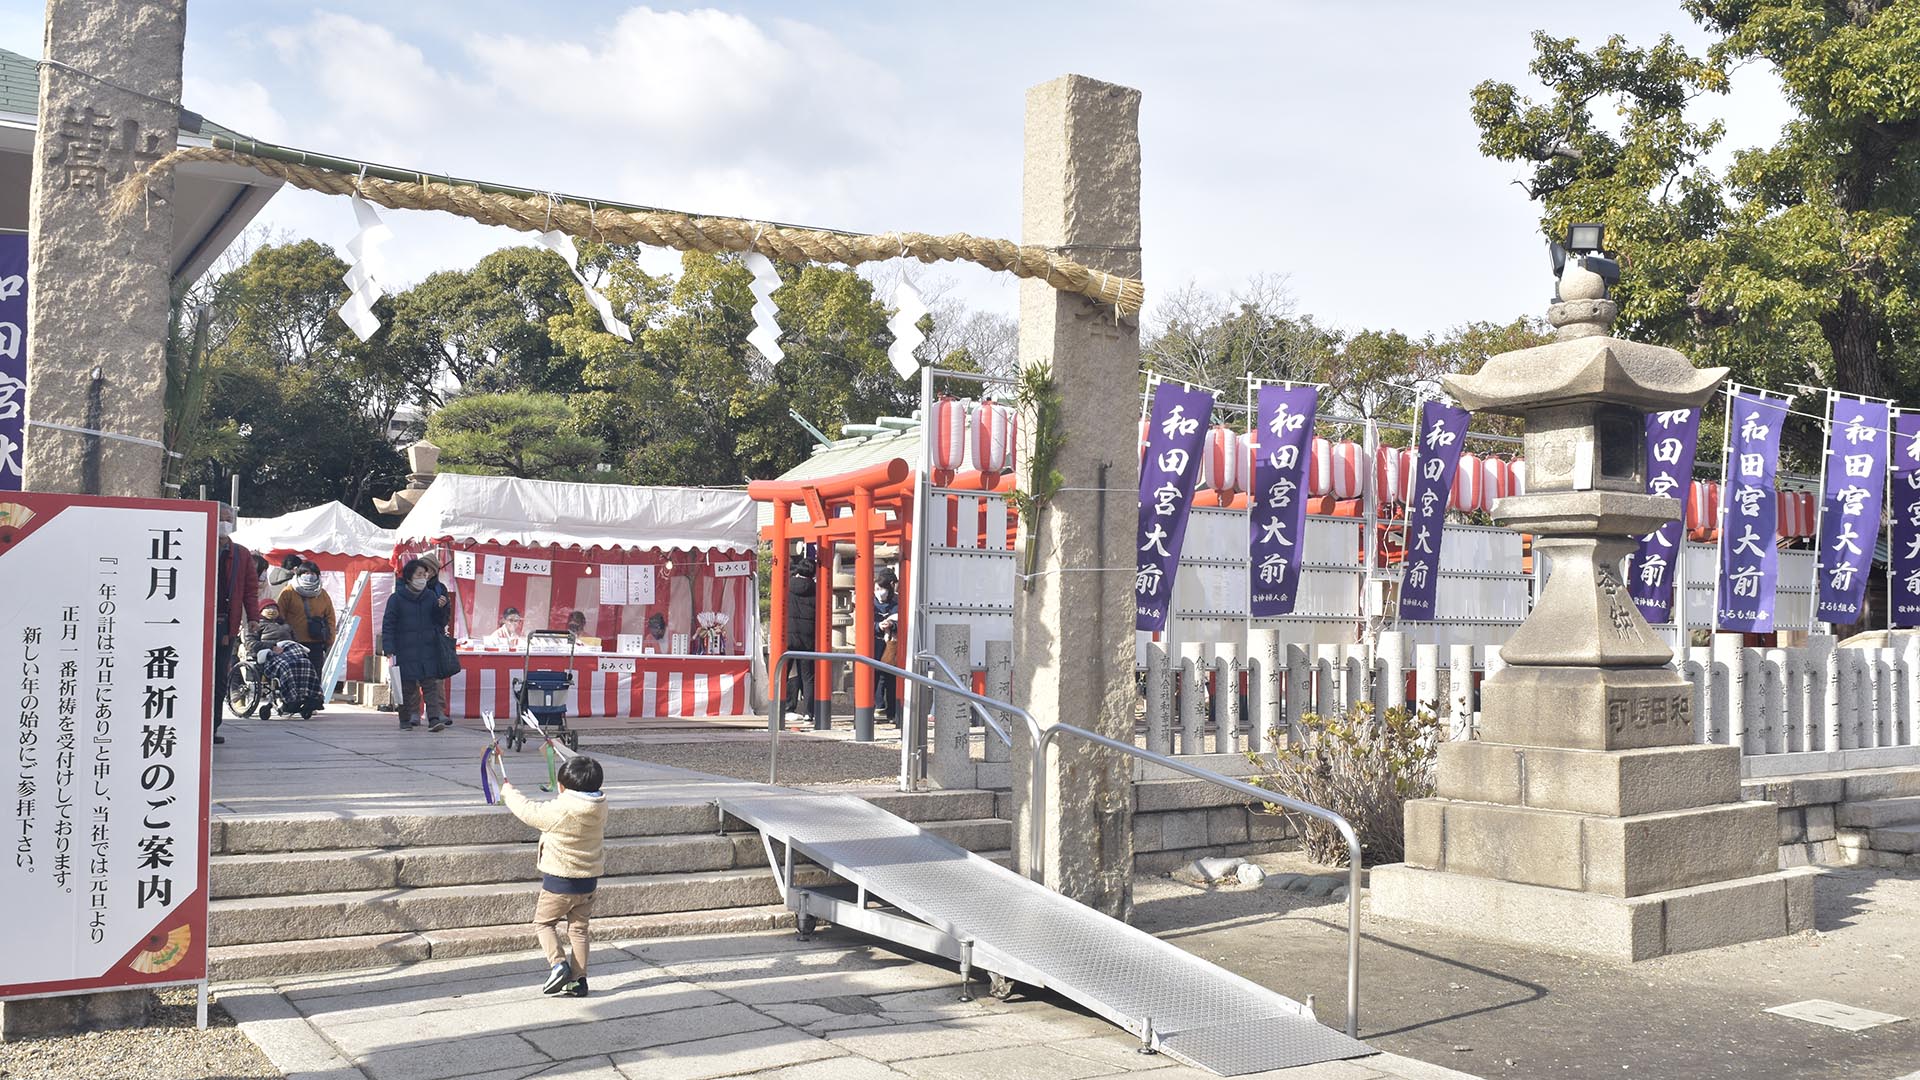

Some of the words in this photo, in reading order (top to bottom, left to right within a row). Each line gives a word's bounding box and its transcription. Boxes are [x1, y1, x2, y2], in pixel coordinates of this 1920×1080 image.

[514, 562, 547, 572] おみくじ
[718, 564, 746, 572] おみくじ
[1136, 405, 1199, 596] 和田宮大前
[1258, 403, 1306, 584] 和田宮大前
[1409, 419, 1456, 590] 和田宮大前
[1729, 412, 1769, 598] 和田宮大前
[1829, 415, 1877, 592] 和田宮大前
[16, 627, 42, 874] 新しい年の始めにご参拝下さい。
[53, 605, 80, 894] 正月一番祈祷を受付けしております。
[89, 557, 118, 944] 『一年の計は元旦にあり』と申し、当社では元旦より
[137, 528, 183, 909] 正月一番祈祷のご案内
[601, 662, 632, 670] おみくじ
